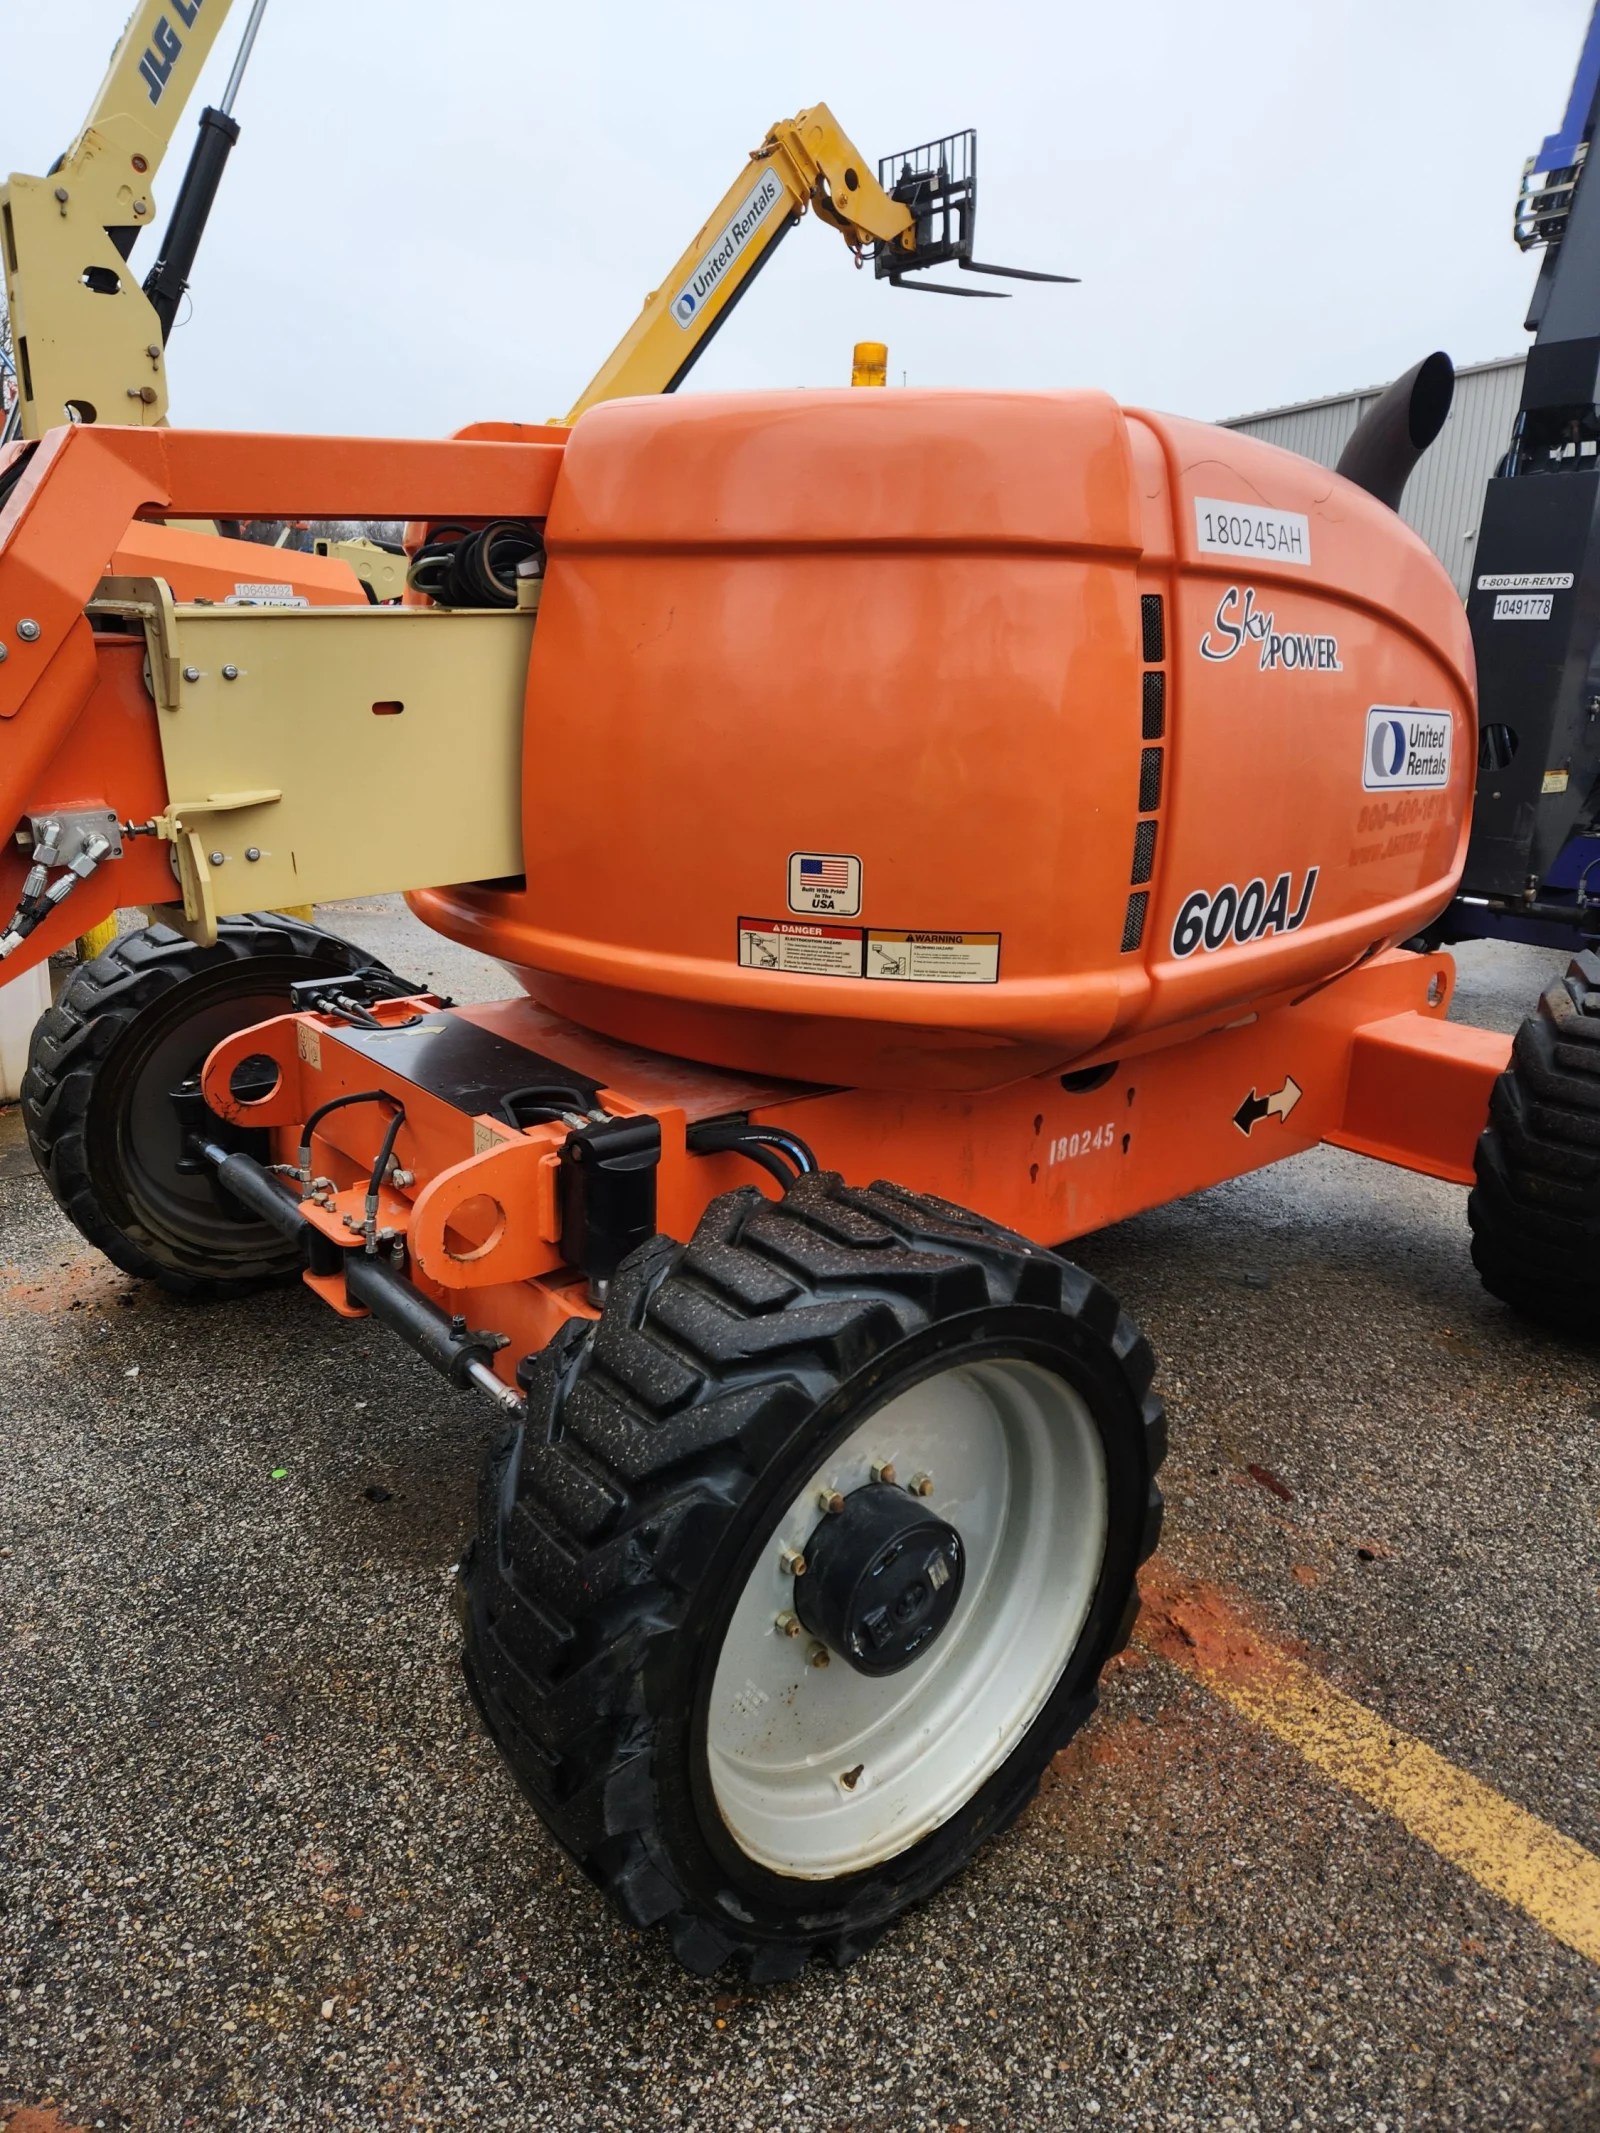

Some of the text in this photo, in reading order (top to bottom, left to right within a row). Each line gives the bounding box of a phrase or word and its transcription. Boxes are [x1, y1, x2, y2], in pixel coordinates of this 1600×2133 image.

[137, 13, 184, 107] JLG
[692, 182, 776, 298] United Rentals
[1204, 513, 1303, 555] 180245AH
[1481, 576, 1570, 587] 1-800-UR-RENTS
[1496, 599, 1551, 615] 10491778
[1409, 723, 1446, 749] United
[1406, 751, 1447, 776] Rentals
[812, 899, 835, 910] USA
[1172, 867, 1319, 958] 600AJ
[781, 925, 823, 936] DANGER
[915, 934, 963, 944] WARNING
[1049, 1122, 1115, 1166] 180245
